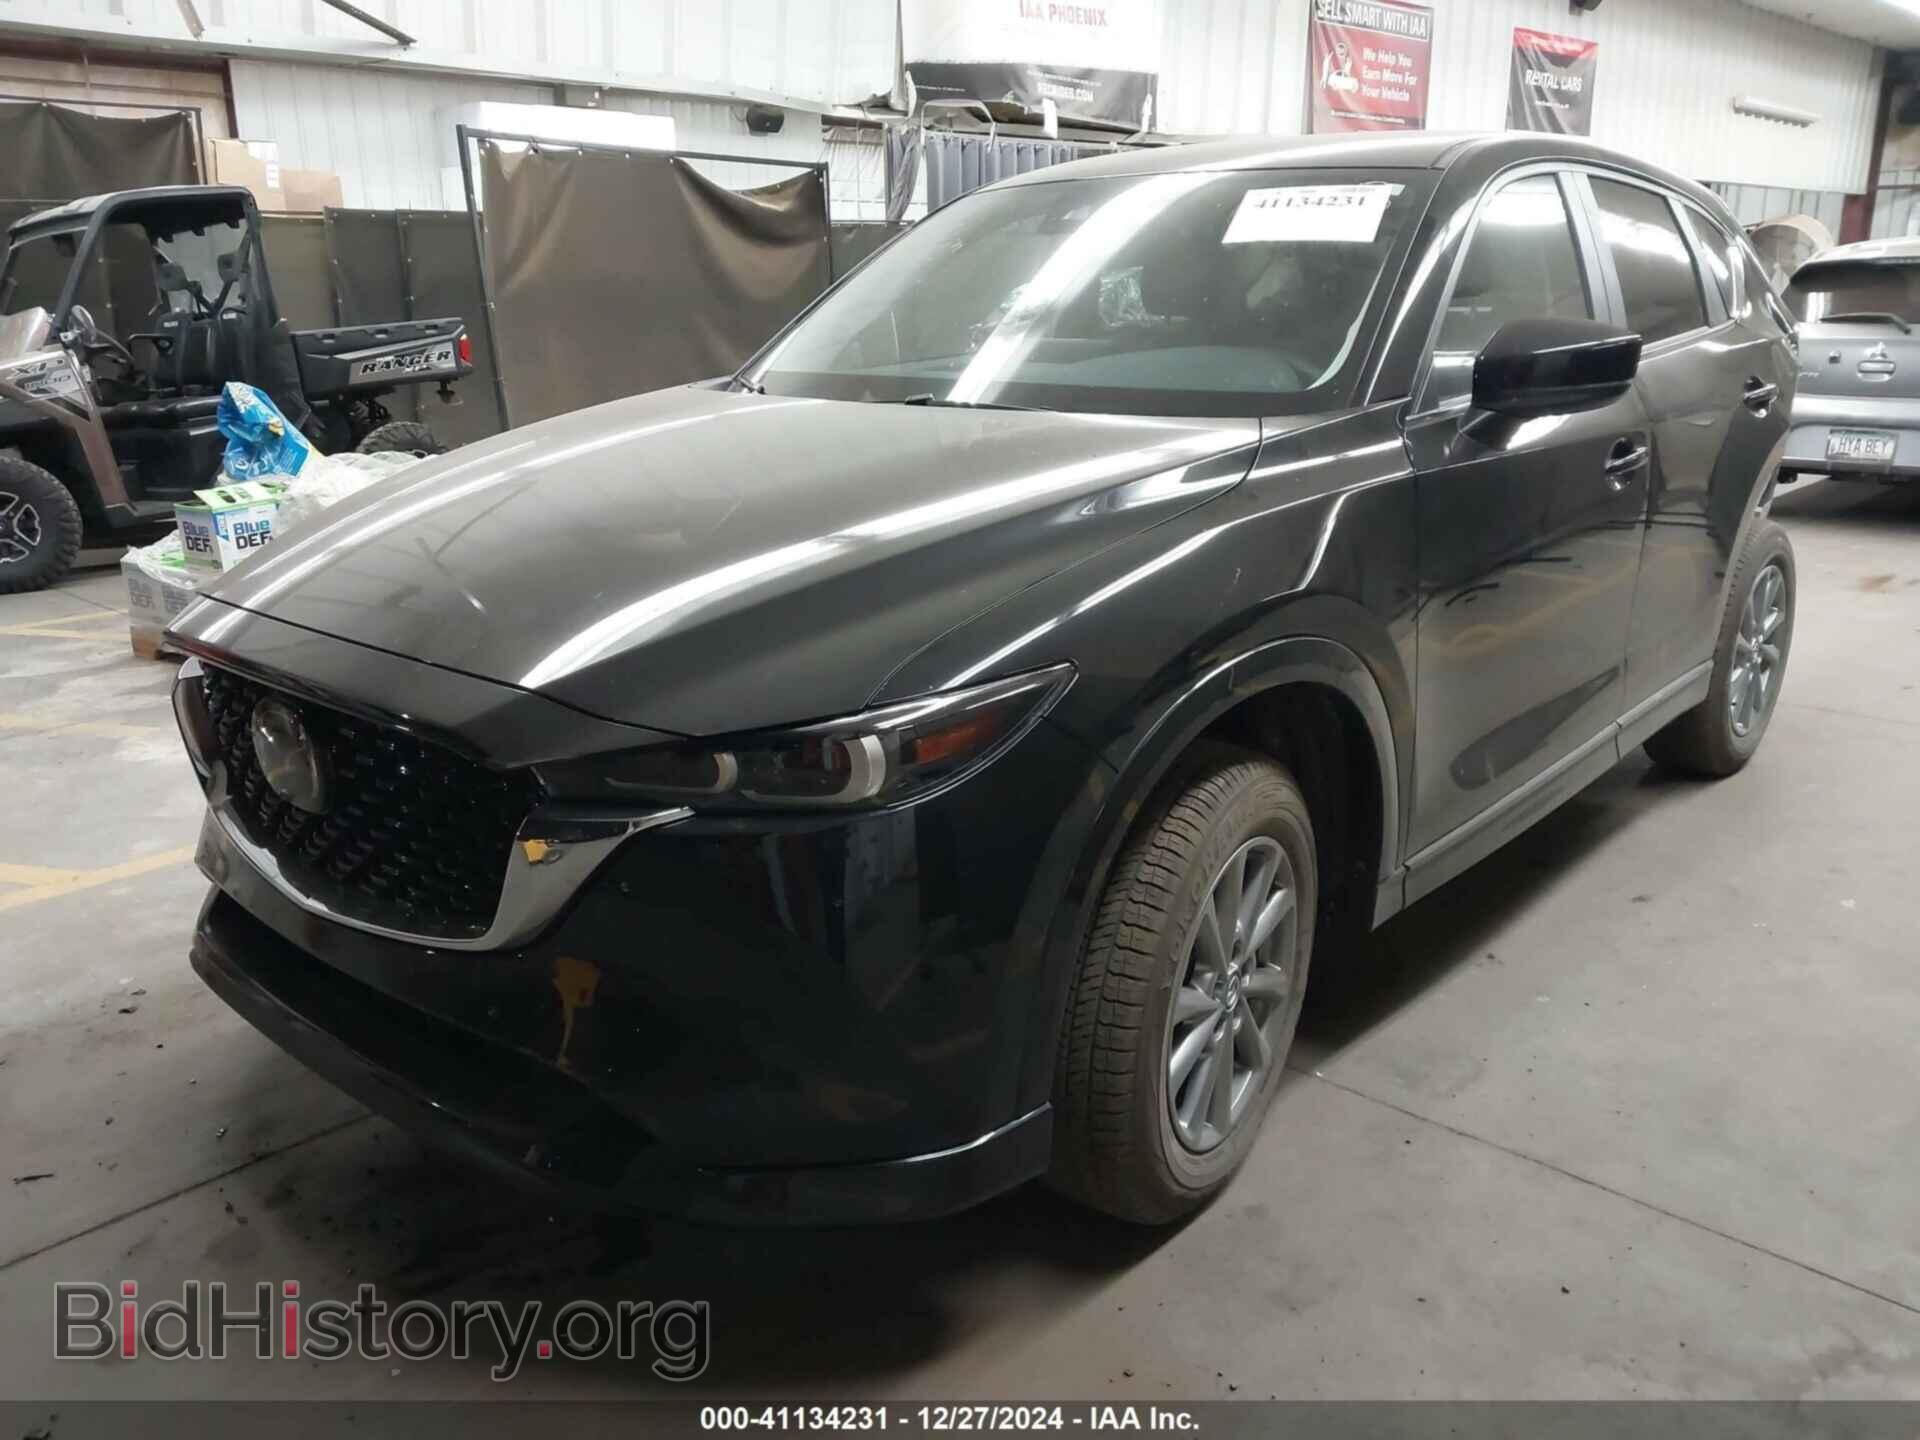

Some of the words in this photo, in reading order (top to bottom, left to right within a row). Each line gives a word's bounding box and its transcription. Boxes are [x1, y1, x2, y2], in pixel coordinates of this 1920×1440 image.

[1018, 0, 1044, 20] IAA
[1048, 3, 1108, 26] PHOENIX
[1317, 0, 1343, 20] SELL
[1344, 3, 1382, 27] SMART
[1383, 10, 1408, 33] WITH
[1409, 15, 1427, 37] IAA
[1362, 48, 1377, 61] We
[1378, 50, 1397, 65] Help
[1398, 52, 1413, 67] You
[1361, 65, 1381, 80] Earn
[1382, 68, 1404, 83] More
[1405, 73, 1418, 86] For
[1525, 69, 1559, 89] RENTAL
[1560, 75, 1583, 92] CARS
[1361, 84, 1381, 98] Your
[1382, 86, 1410, 102] Vehicle
[360, 350, 452, 375] RANGER
[182, 520, 209, 536] Blue
[233, 519, 270, 535] Blue
[185, 535, 212, 552] DEF
[235, 530, 273, 549] DEF
